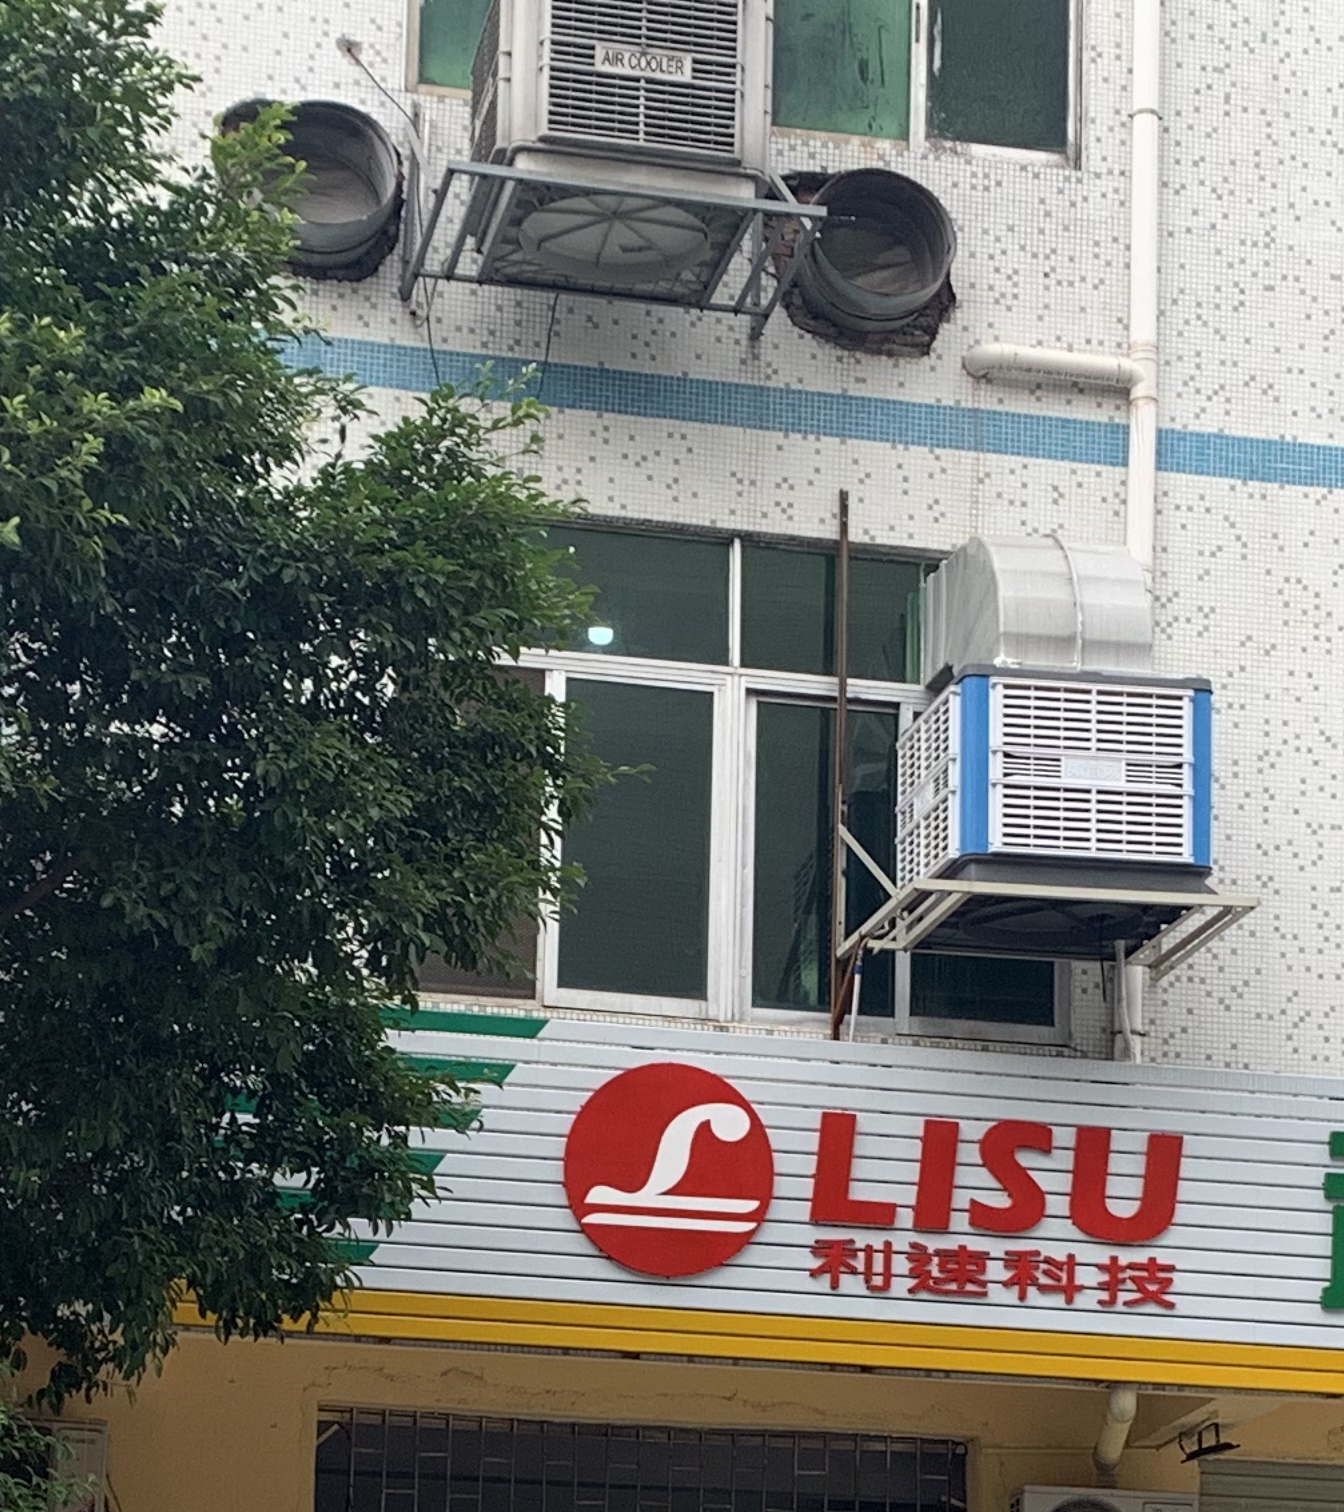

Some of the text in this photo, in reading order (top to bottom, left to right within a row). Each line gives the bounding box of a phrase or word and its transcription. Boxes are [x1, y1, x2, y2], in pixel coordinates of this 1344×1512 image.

[601, 50, 685, 75] AIR COOLER
[807, 1111, 1183, 1245] LISU
[807, 1238, 1178, 1311] 利速科技
